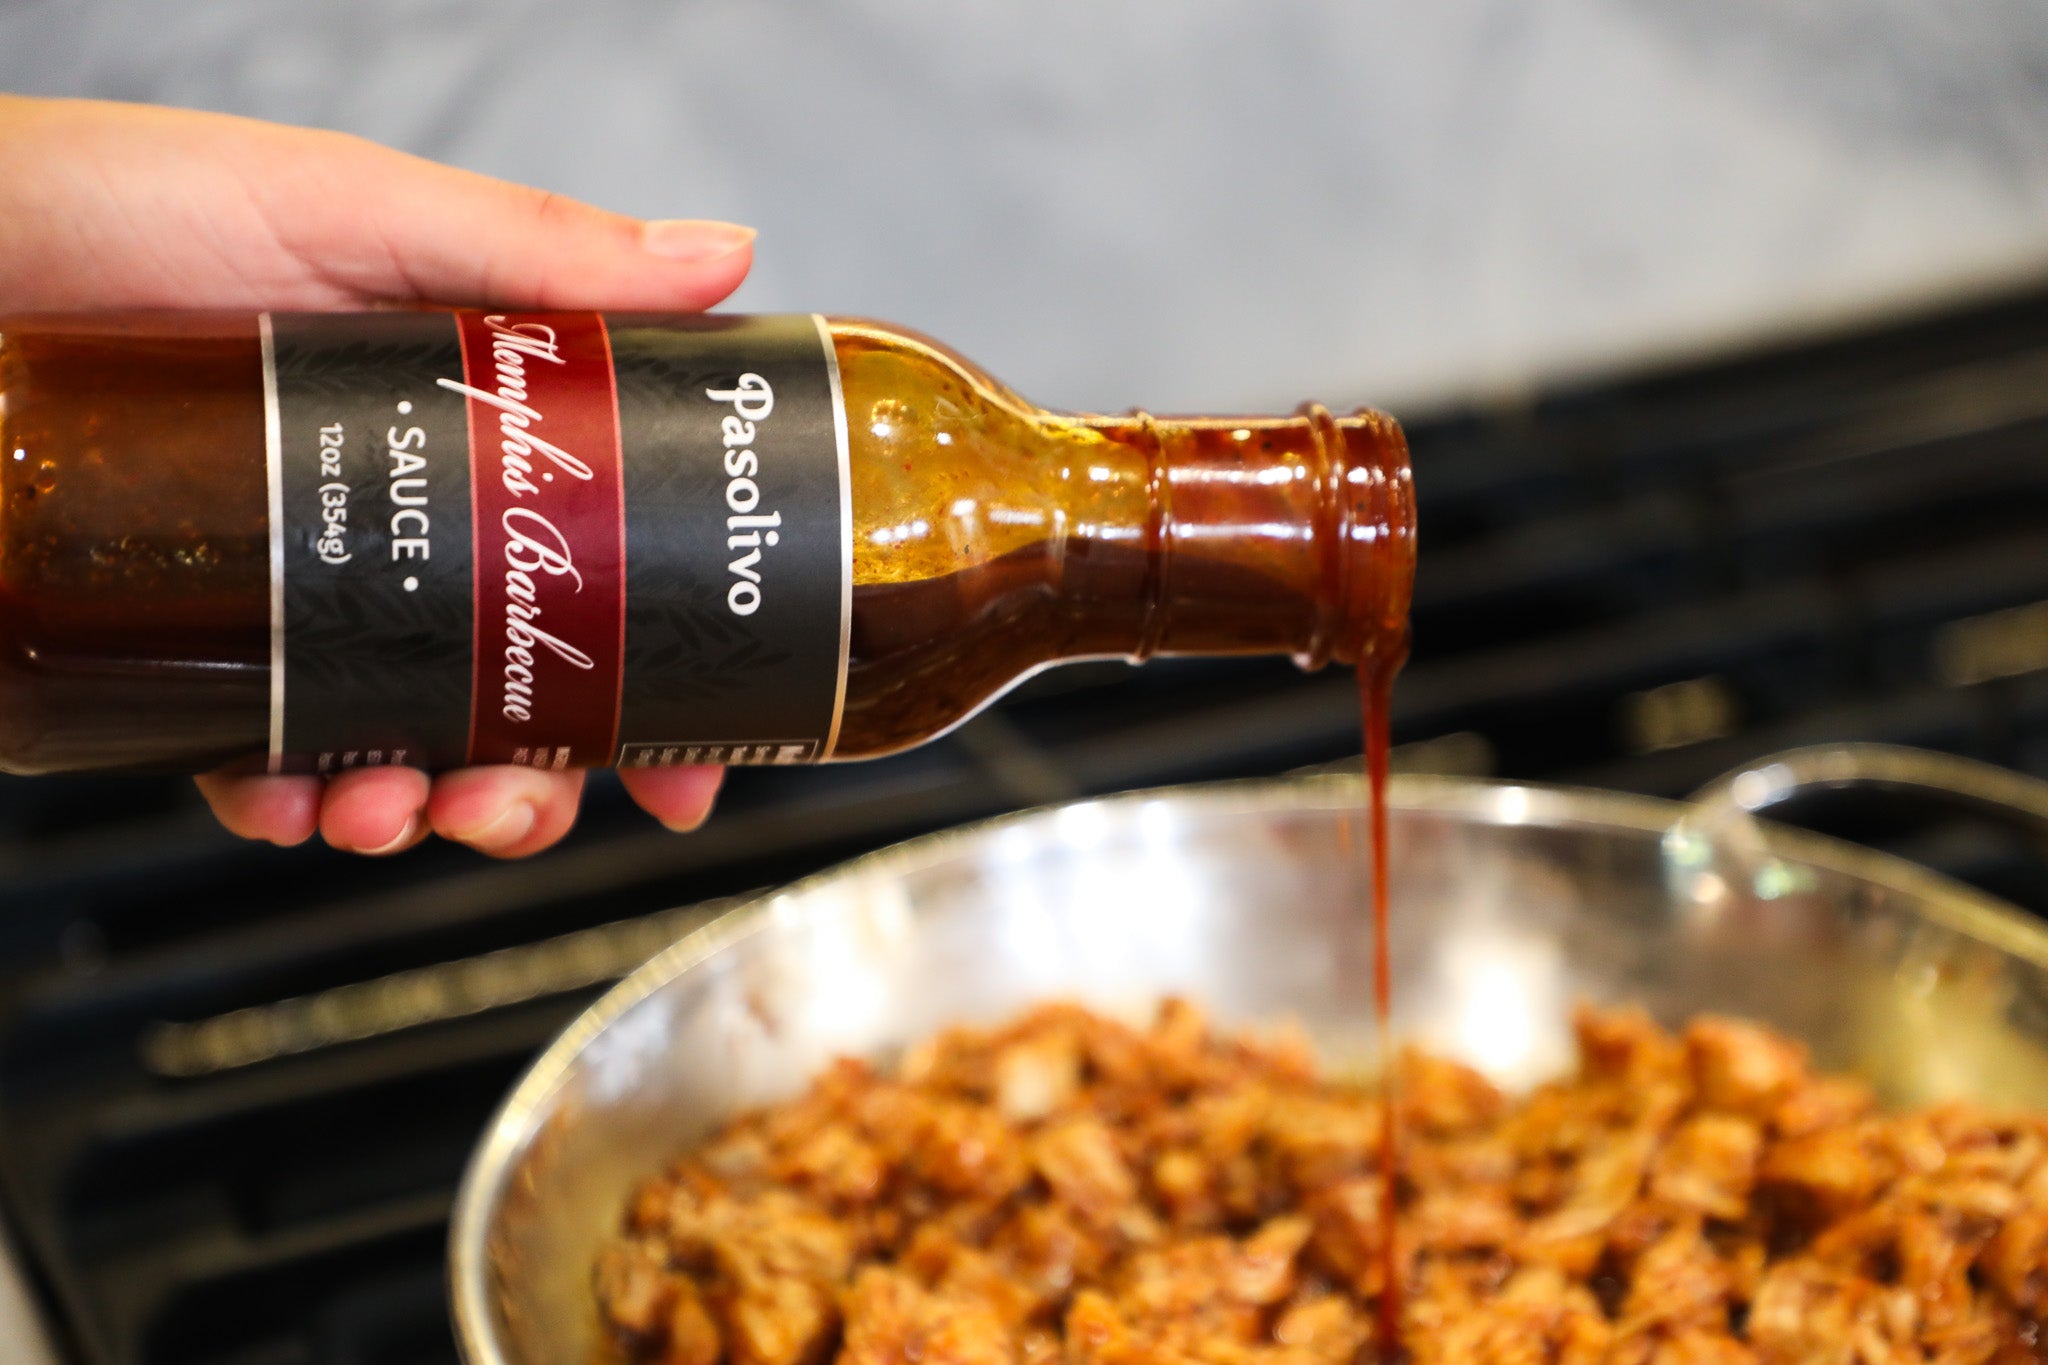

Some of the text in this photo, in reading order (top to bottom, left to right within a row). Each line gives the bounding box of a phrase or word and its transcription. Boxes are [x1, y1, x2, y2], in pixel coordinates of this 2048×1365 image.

[317, 422, 352, 565] 12oz (354g)
[387, 426, 429, 562] SAUCE
[436, 315, 593, 498] Memphis
[706, 372, 782, 616] Pasolivo
[502, 507, 594, 722] Barbecue
